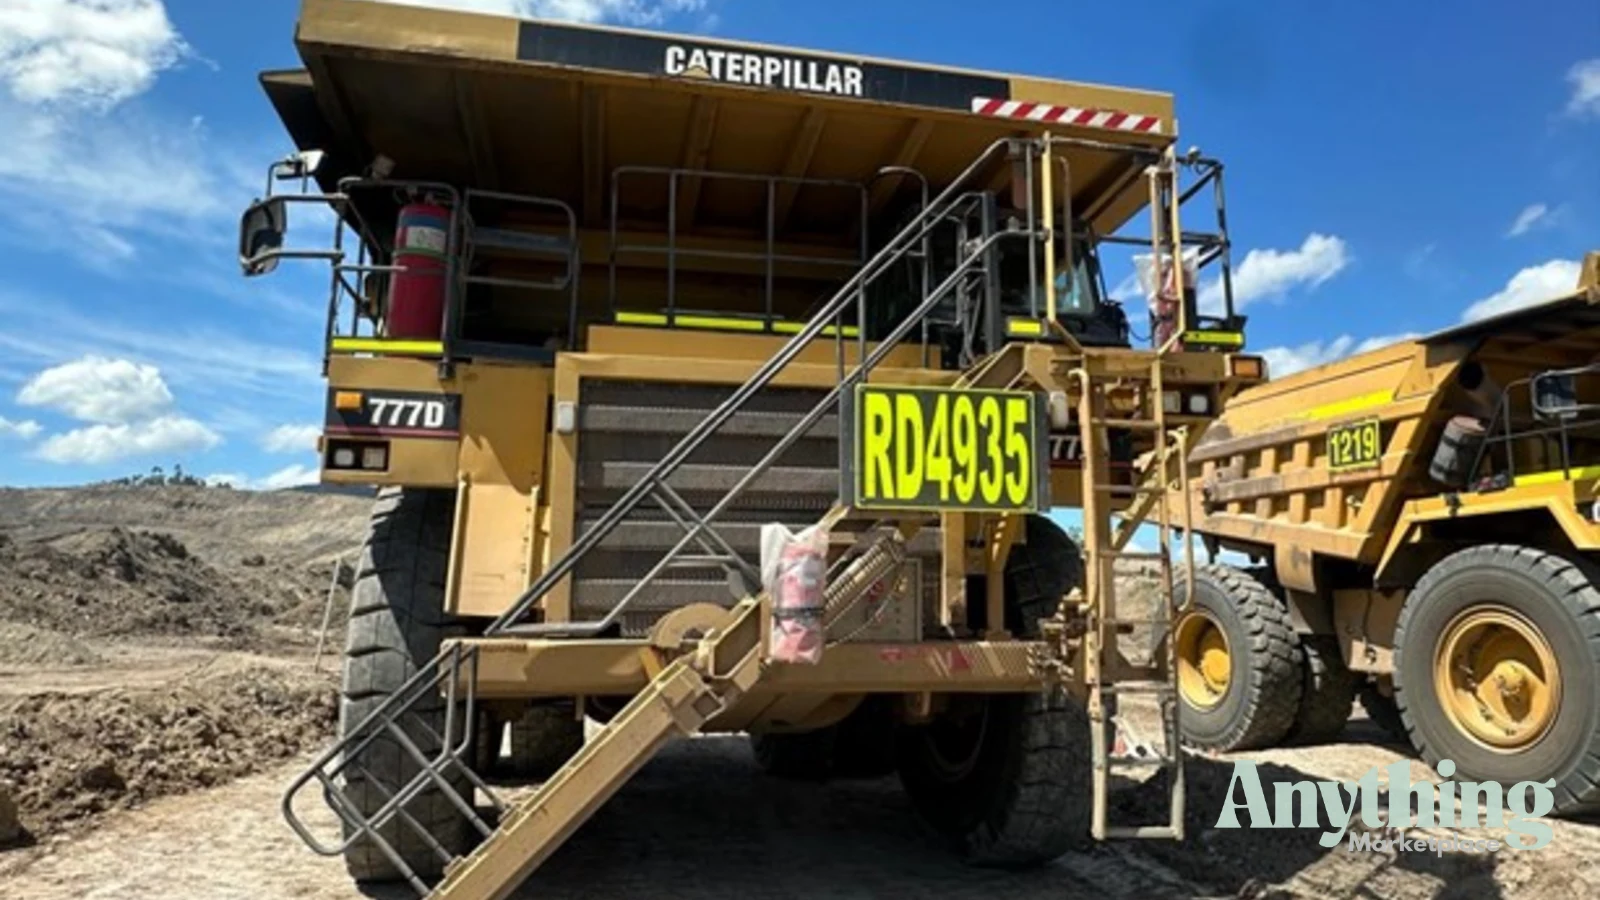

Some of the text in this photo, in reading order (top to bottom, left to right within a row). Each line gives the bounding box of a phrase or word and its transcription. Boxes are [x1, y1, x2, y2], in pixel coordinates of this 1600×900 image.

[665, 46, 863, 97] CATERPILLAR
[369, 398, 444, 427] 777D
[865, 392, 1030, 504] RD4935
[1331, 426, 1374, 465] 1219
